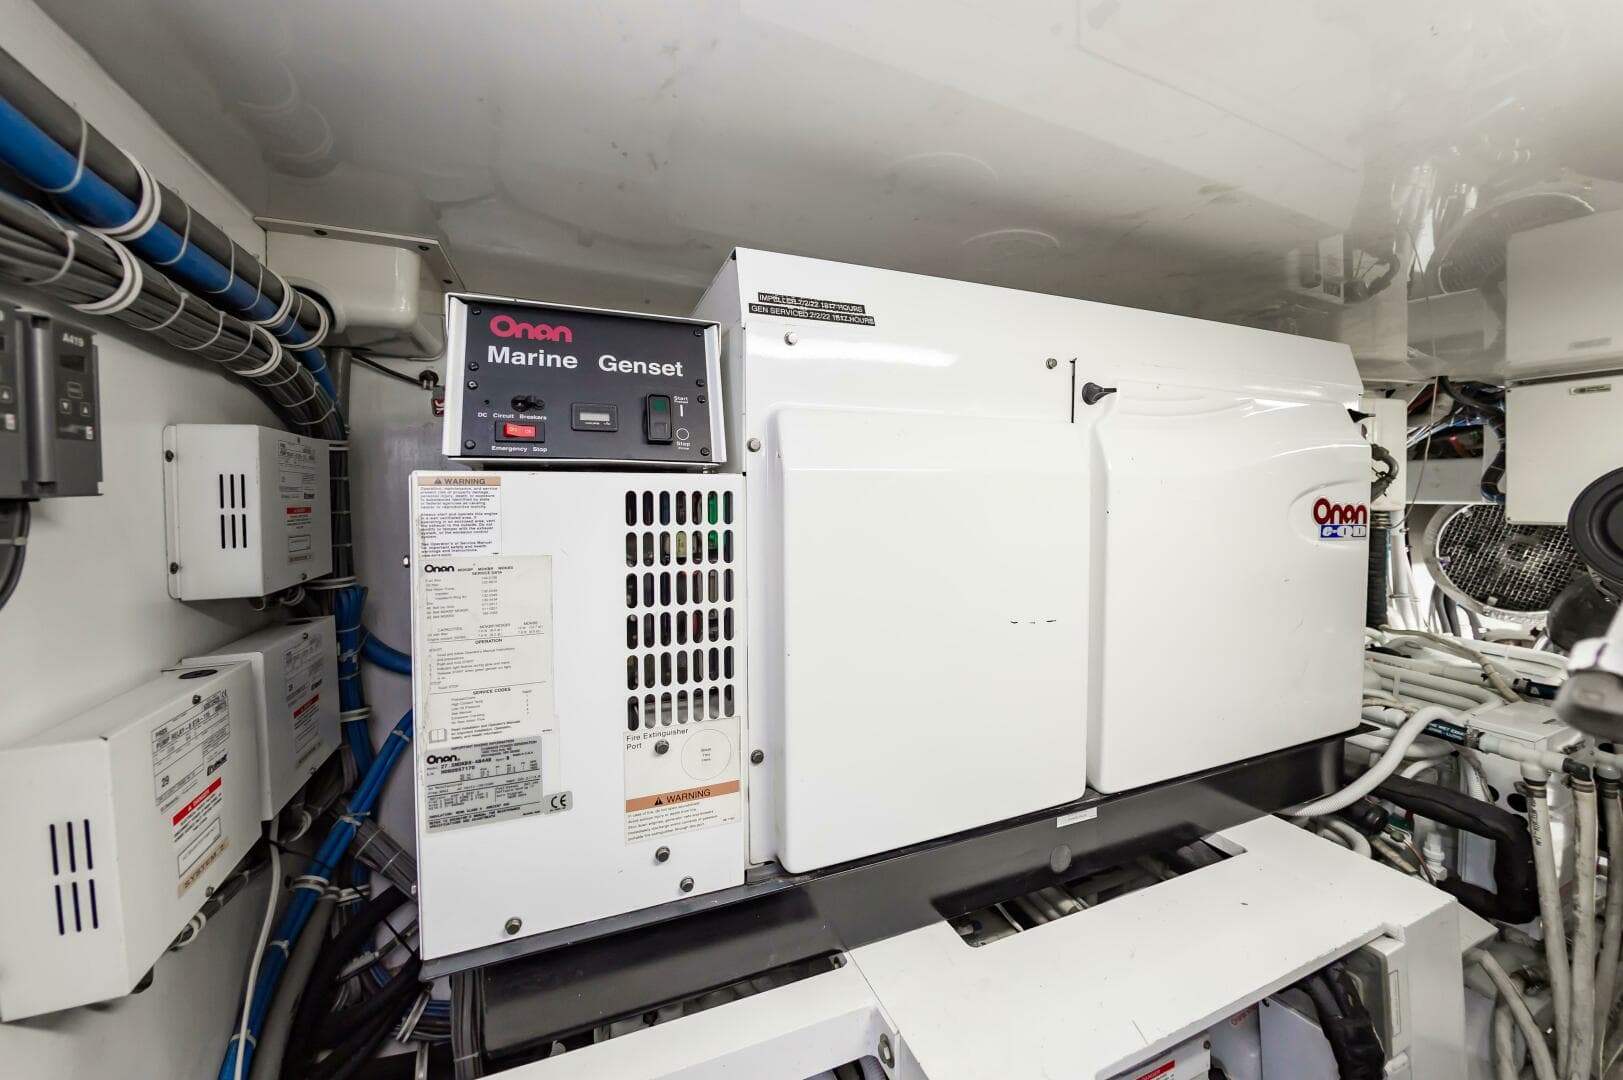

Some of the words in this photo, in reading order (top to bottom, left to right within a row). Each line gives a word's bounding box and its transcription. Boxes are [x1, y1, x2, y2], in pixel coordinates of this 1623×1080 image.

[751, 304, 768, 313] GEN
[770, 306, 808, 318] SERVICED
[490, 314, 572, 342] Onan
[62, 332, 84, 348] A419
[488, 346, 578, 369] Marine
[598, 354, 684, 376] Genset
[1313, 498, 1368, 524] Onan
[424, 564, 454, 573] Onan
[644, 729, 688, 740] Extinguisher
[626, 742, 642, 750] Port
[426, 754, 458, 764] Onan
[551, 794, 567, 808] CE
[666, 789, 711, 803] WARNING
